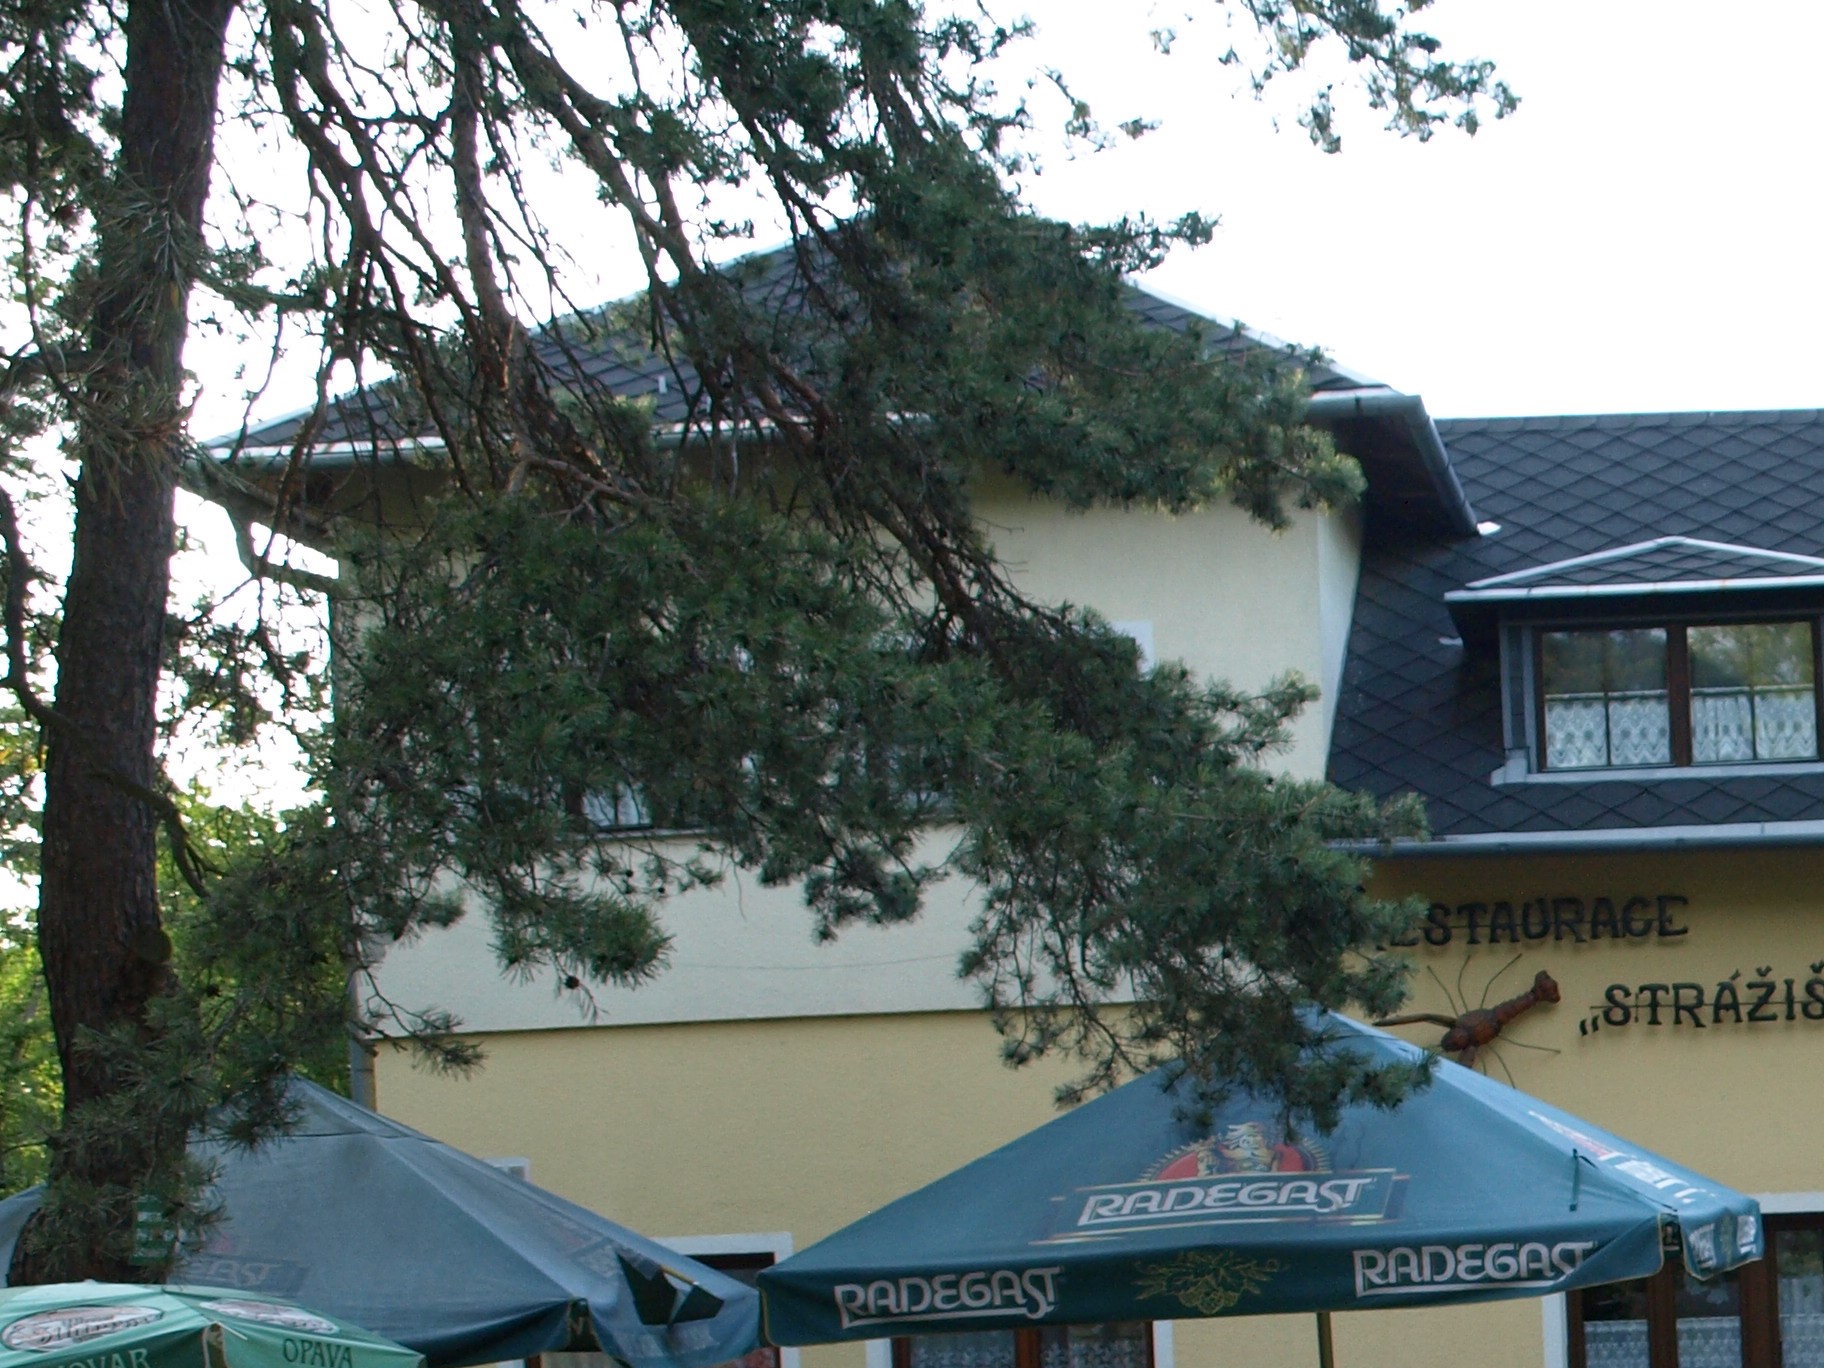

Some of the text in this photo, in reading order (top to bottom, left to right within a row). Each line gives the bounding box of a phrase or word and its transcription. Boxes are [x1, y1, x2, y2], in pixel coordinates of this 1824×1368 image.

[1077, 1177, 1377, 1226] RADEGAST
[833, 1266, 1064, 1329] RADEGAST
[1353, 1241, 1598, 1298] RADEGAST
